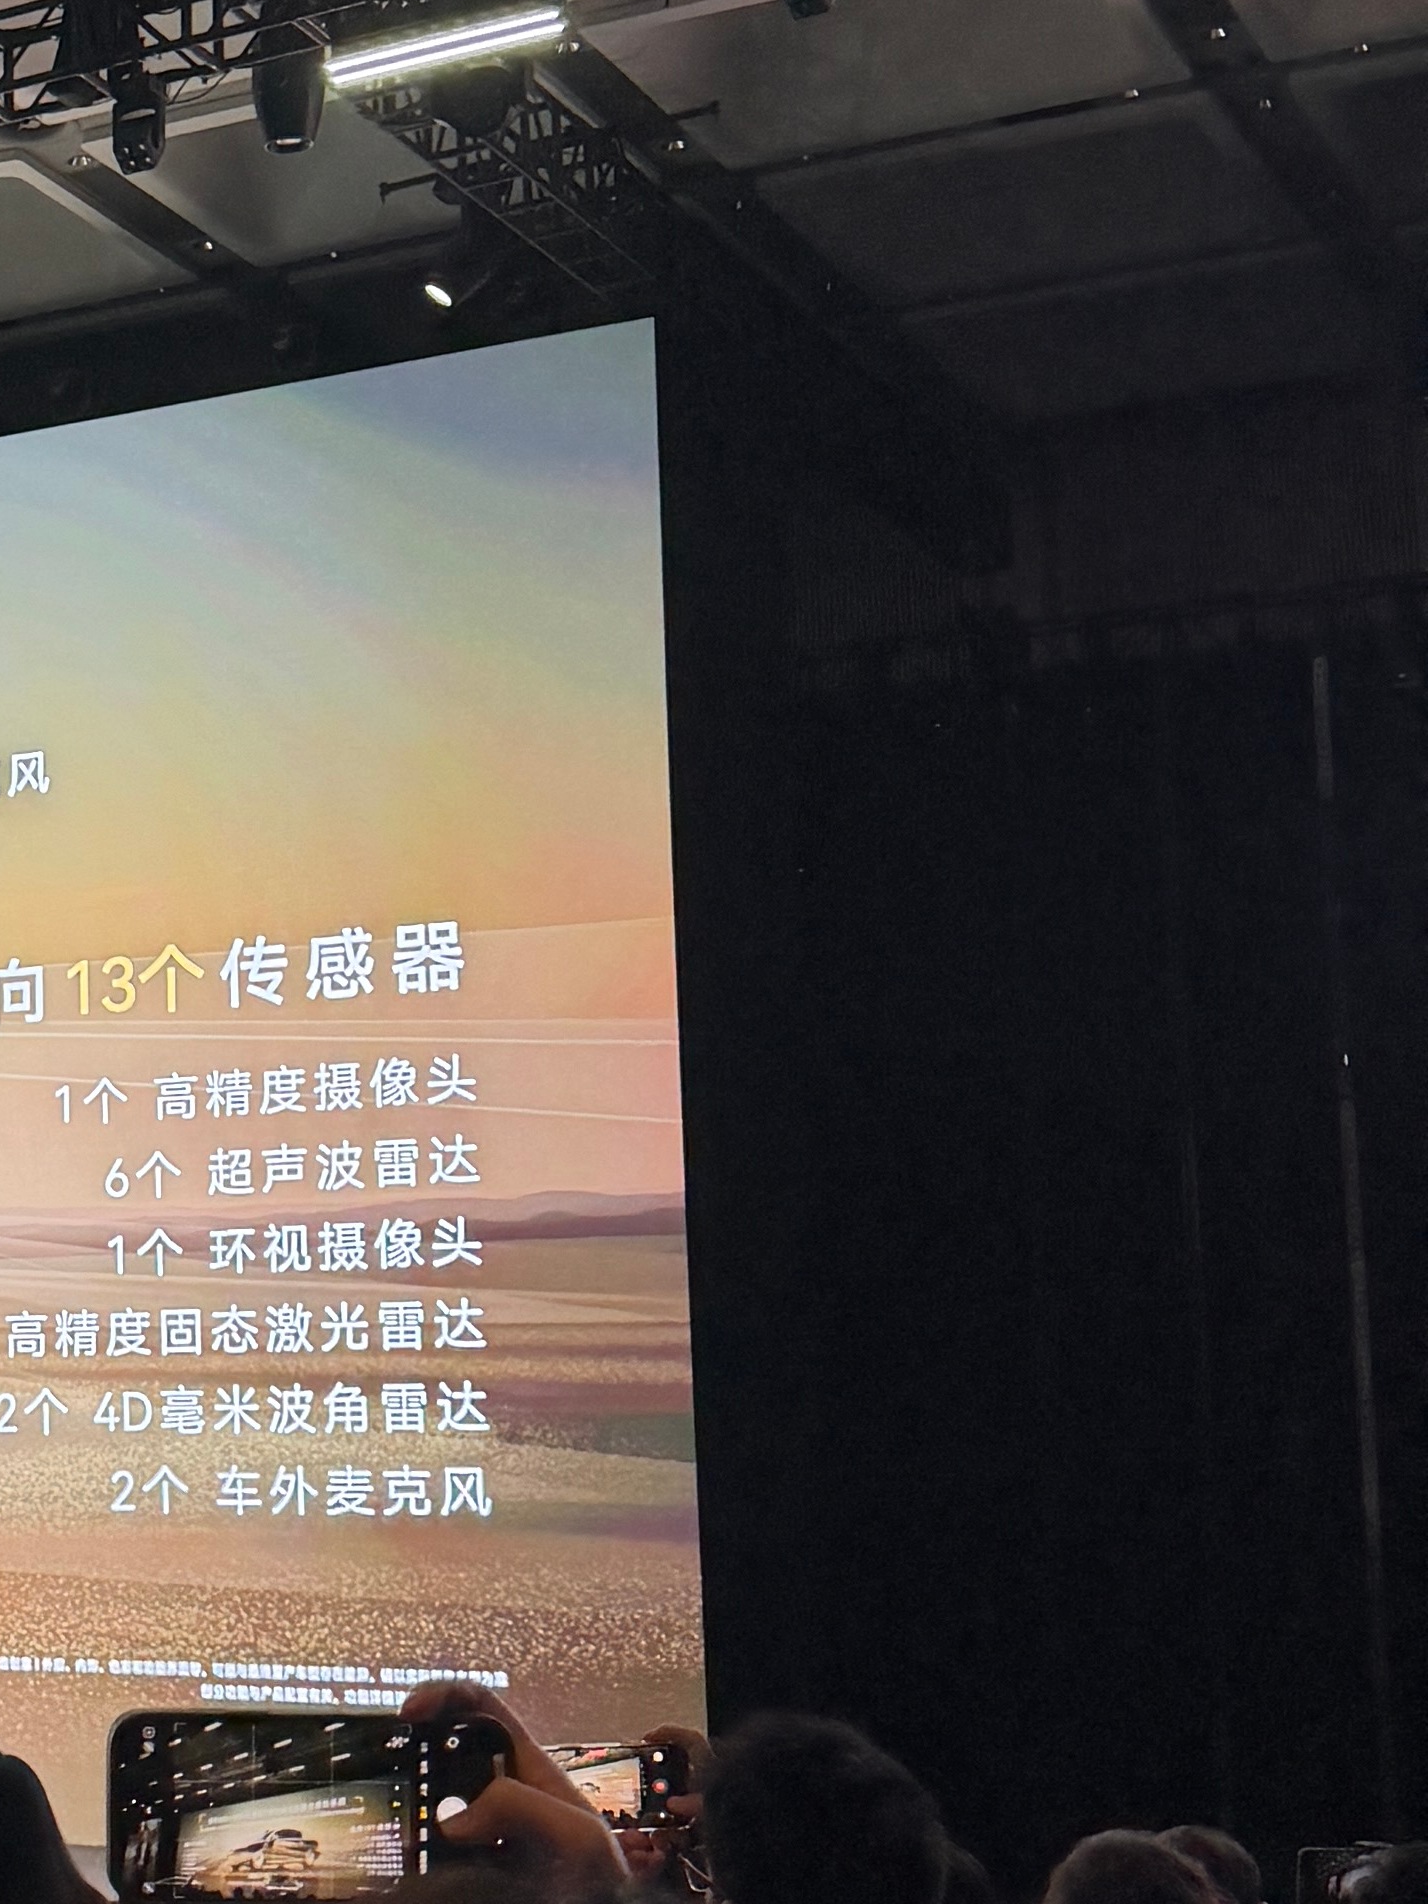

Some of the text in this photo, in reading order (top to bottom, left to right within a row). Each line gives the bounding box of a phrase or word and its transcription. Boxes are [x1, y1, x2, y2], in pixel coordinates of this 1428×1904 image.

[54, 1053, 477, 1125] 1个 高精度摄像头
[104, 1133, 481, 1199] 6个 超声波雷达
[107, 1215, 483, 1277] 1个 环视摄像头
[4, 1296, 487, 1359] 高精度固态激光雷达
[92, 1379, 491, 1437] 4D毫米波角雷达
[110, 1463, 493, 1517] 2个 车外麦克风
